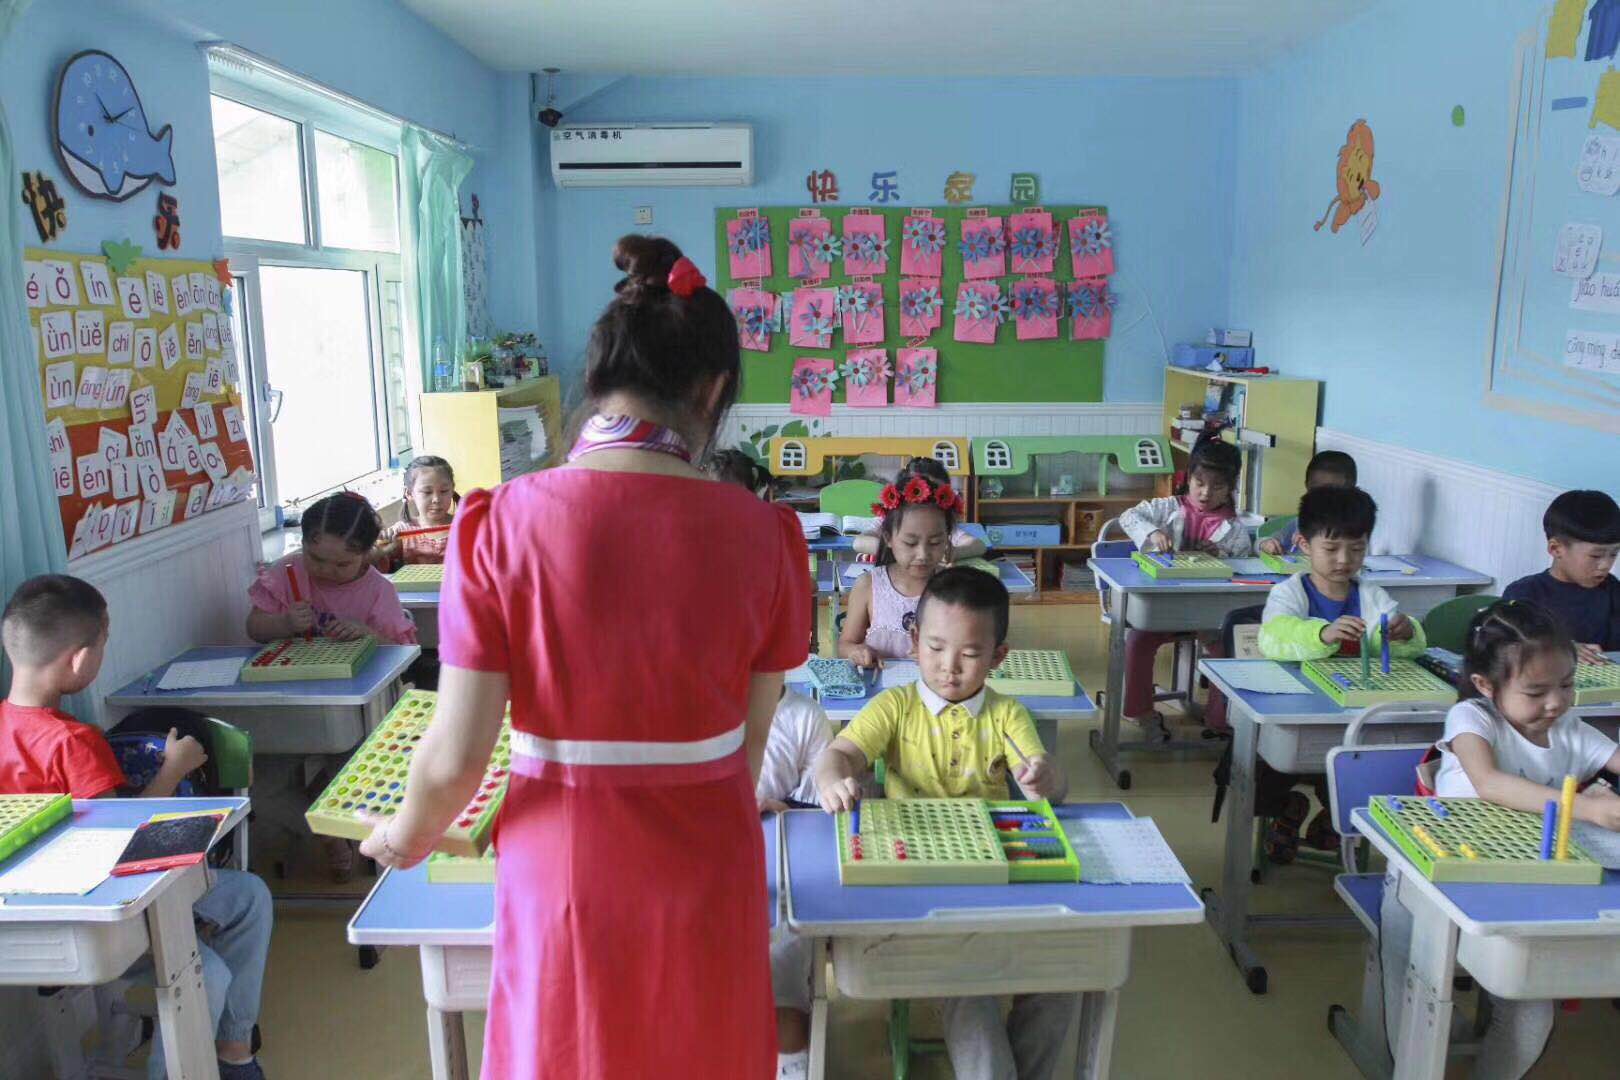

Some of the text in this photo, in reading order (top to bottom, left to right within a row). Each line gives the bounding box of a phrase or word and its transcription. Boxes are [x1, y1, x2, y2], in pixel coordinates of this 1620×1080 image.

[563, 130, 622, 140] 空气消毒机
